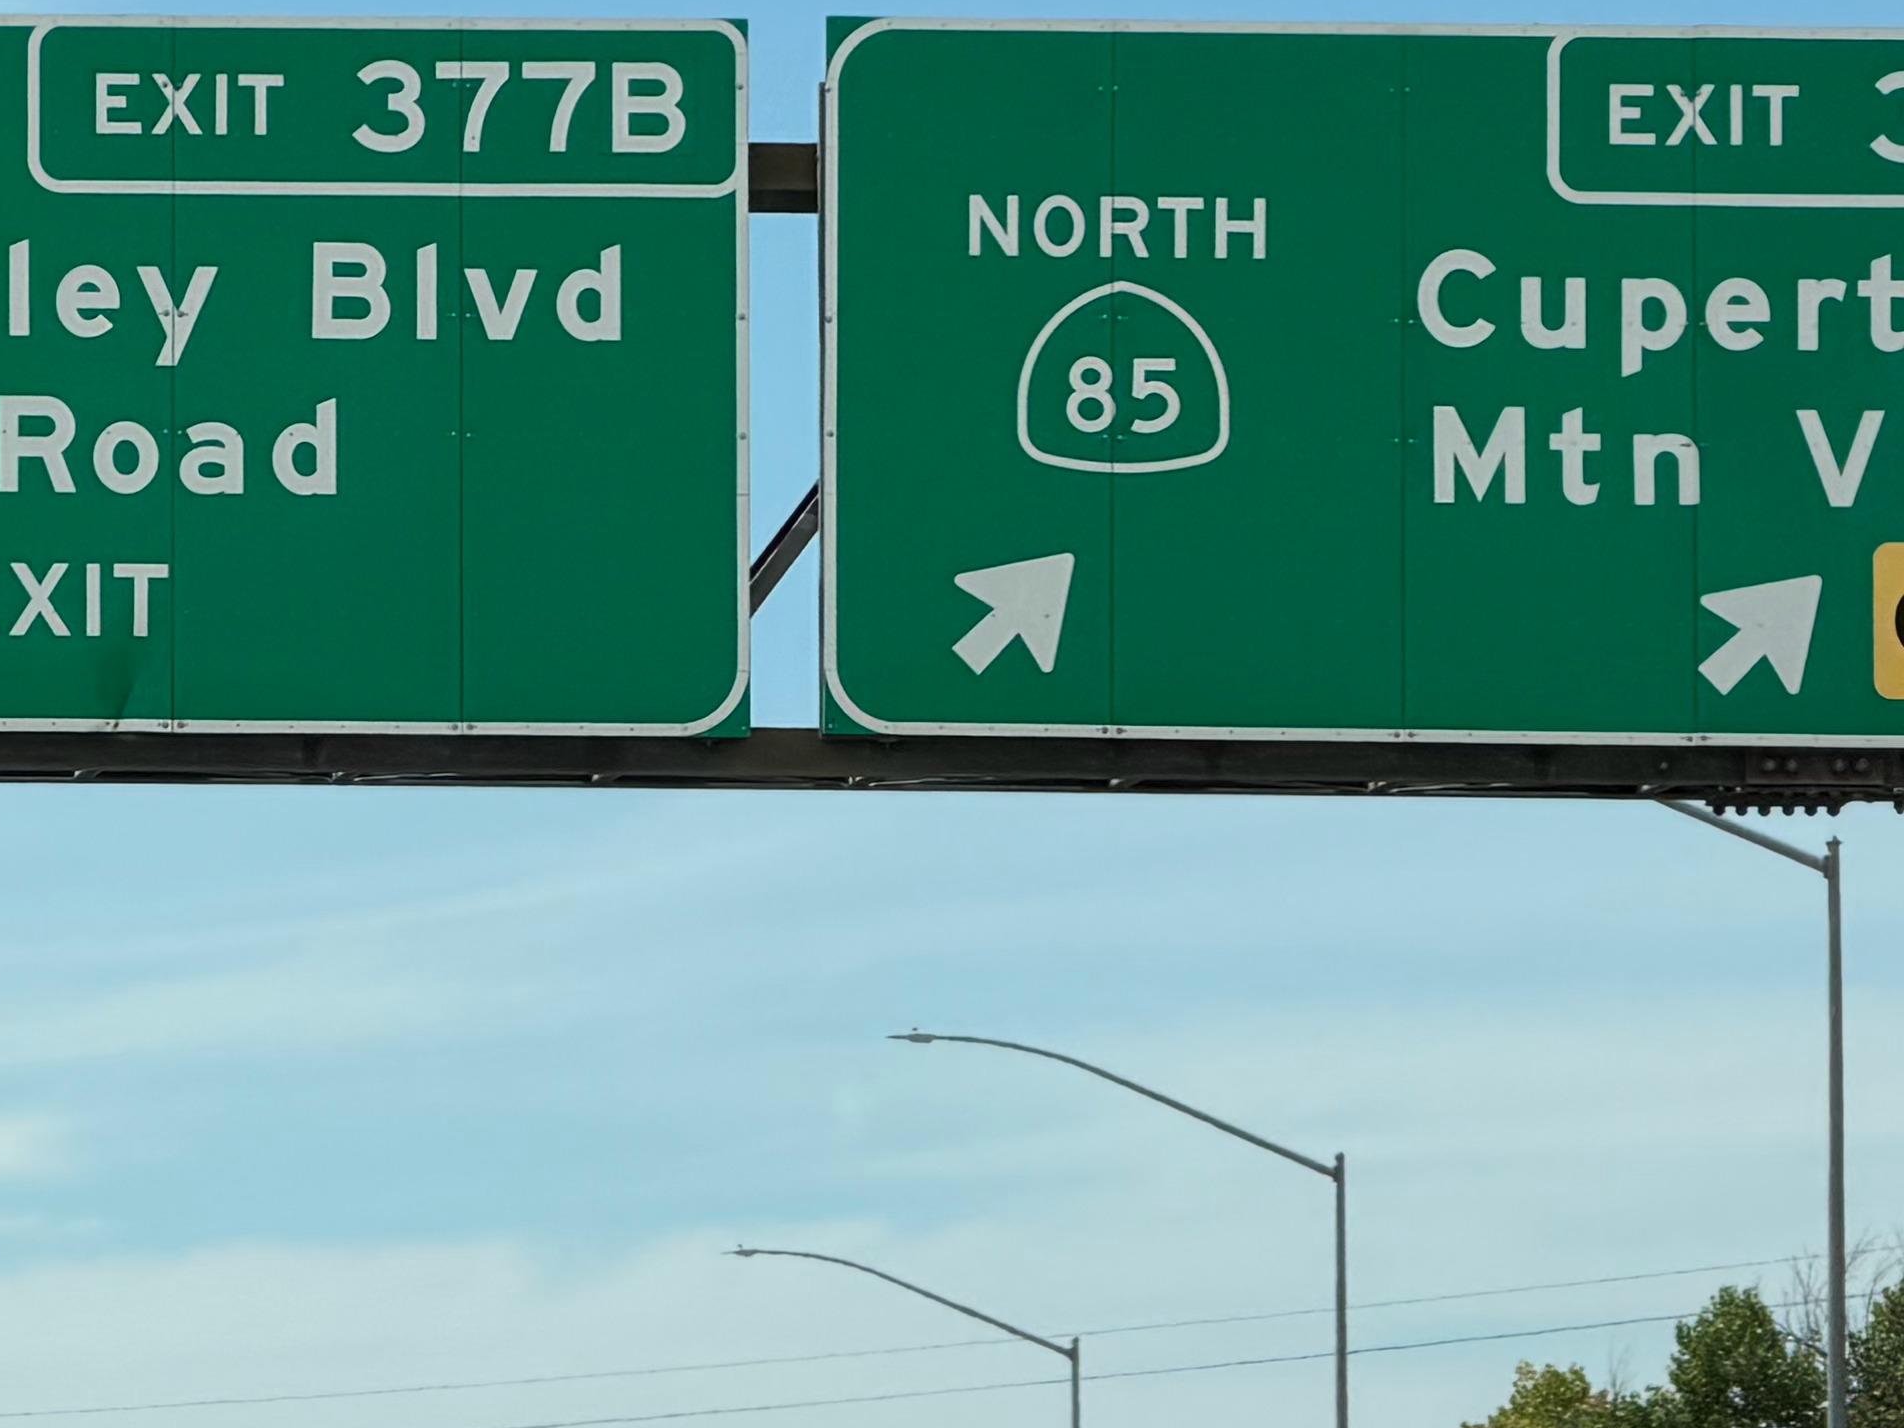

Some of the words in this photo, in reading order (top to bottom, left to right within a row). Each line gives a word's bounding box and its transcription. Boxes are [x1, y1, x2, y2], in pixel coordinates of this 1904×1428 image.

[95, 72, 285, 136] EXIT
[352, 59, 687, 154] 377B
[1609, 83, 1800, 147] EXIT
[968, 194, 1268, 260] NORTH
[311, 241, 623, 342] Blvd
[1066, 356, 1181, 434] 85
[1433, 405, 1701, 506] Mtn
